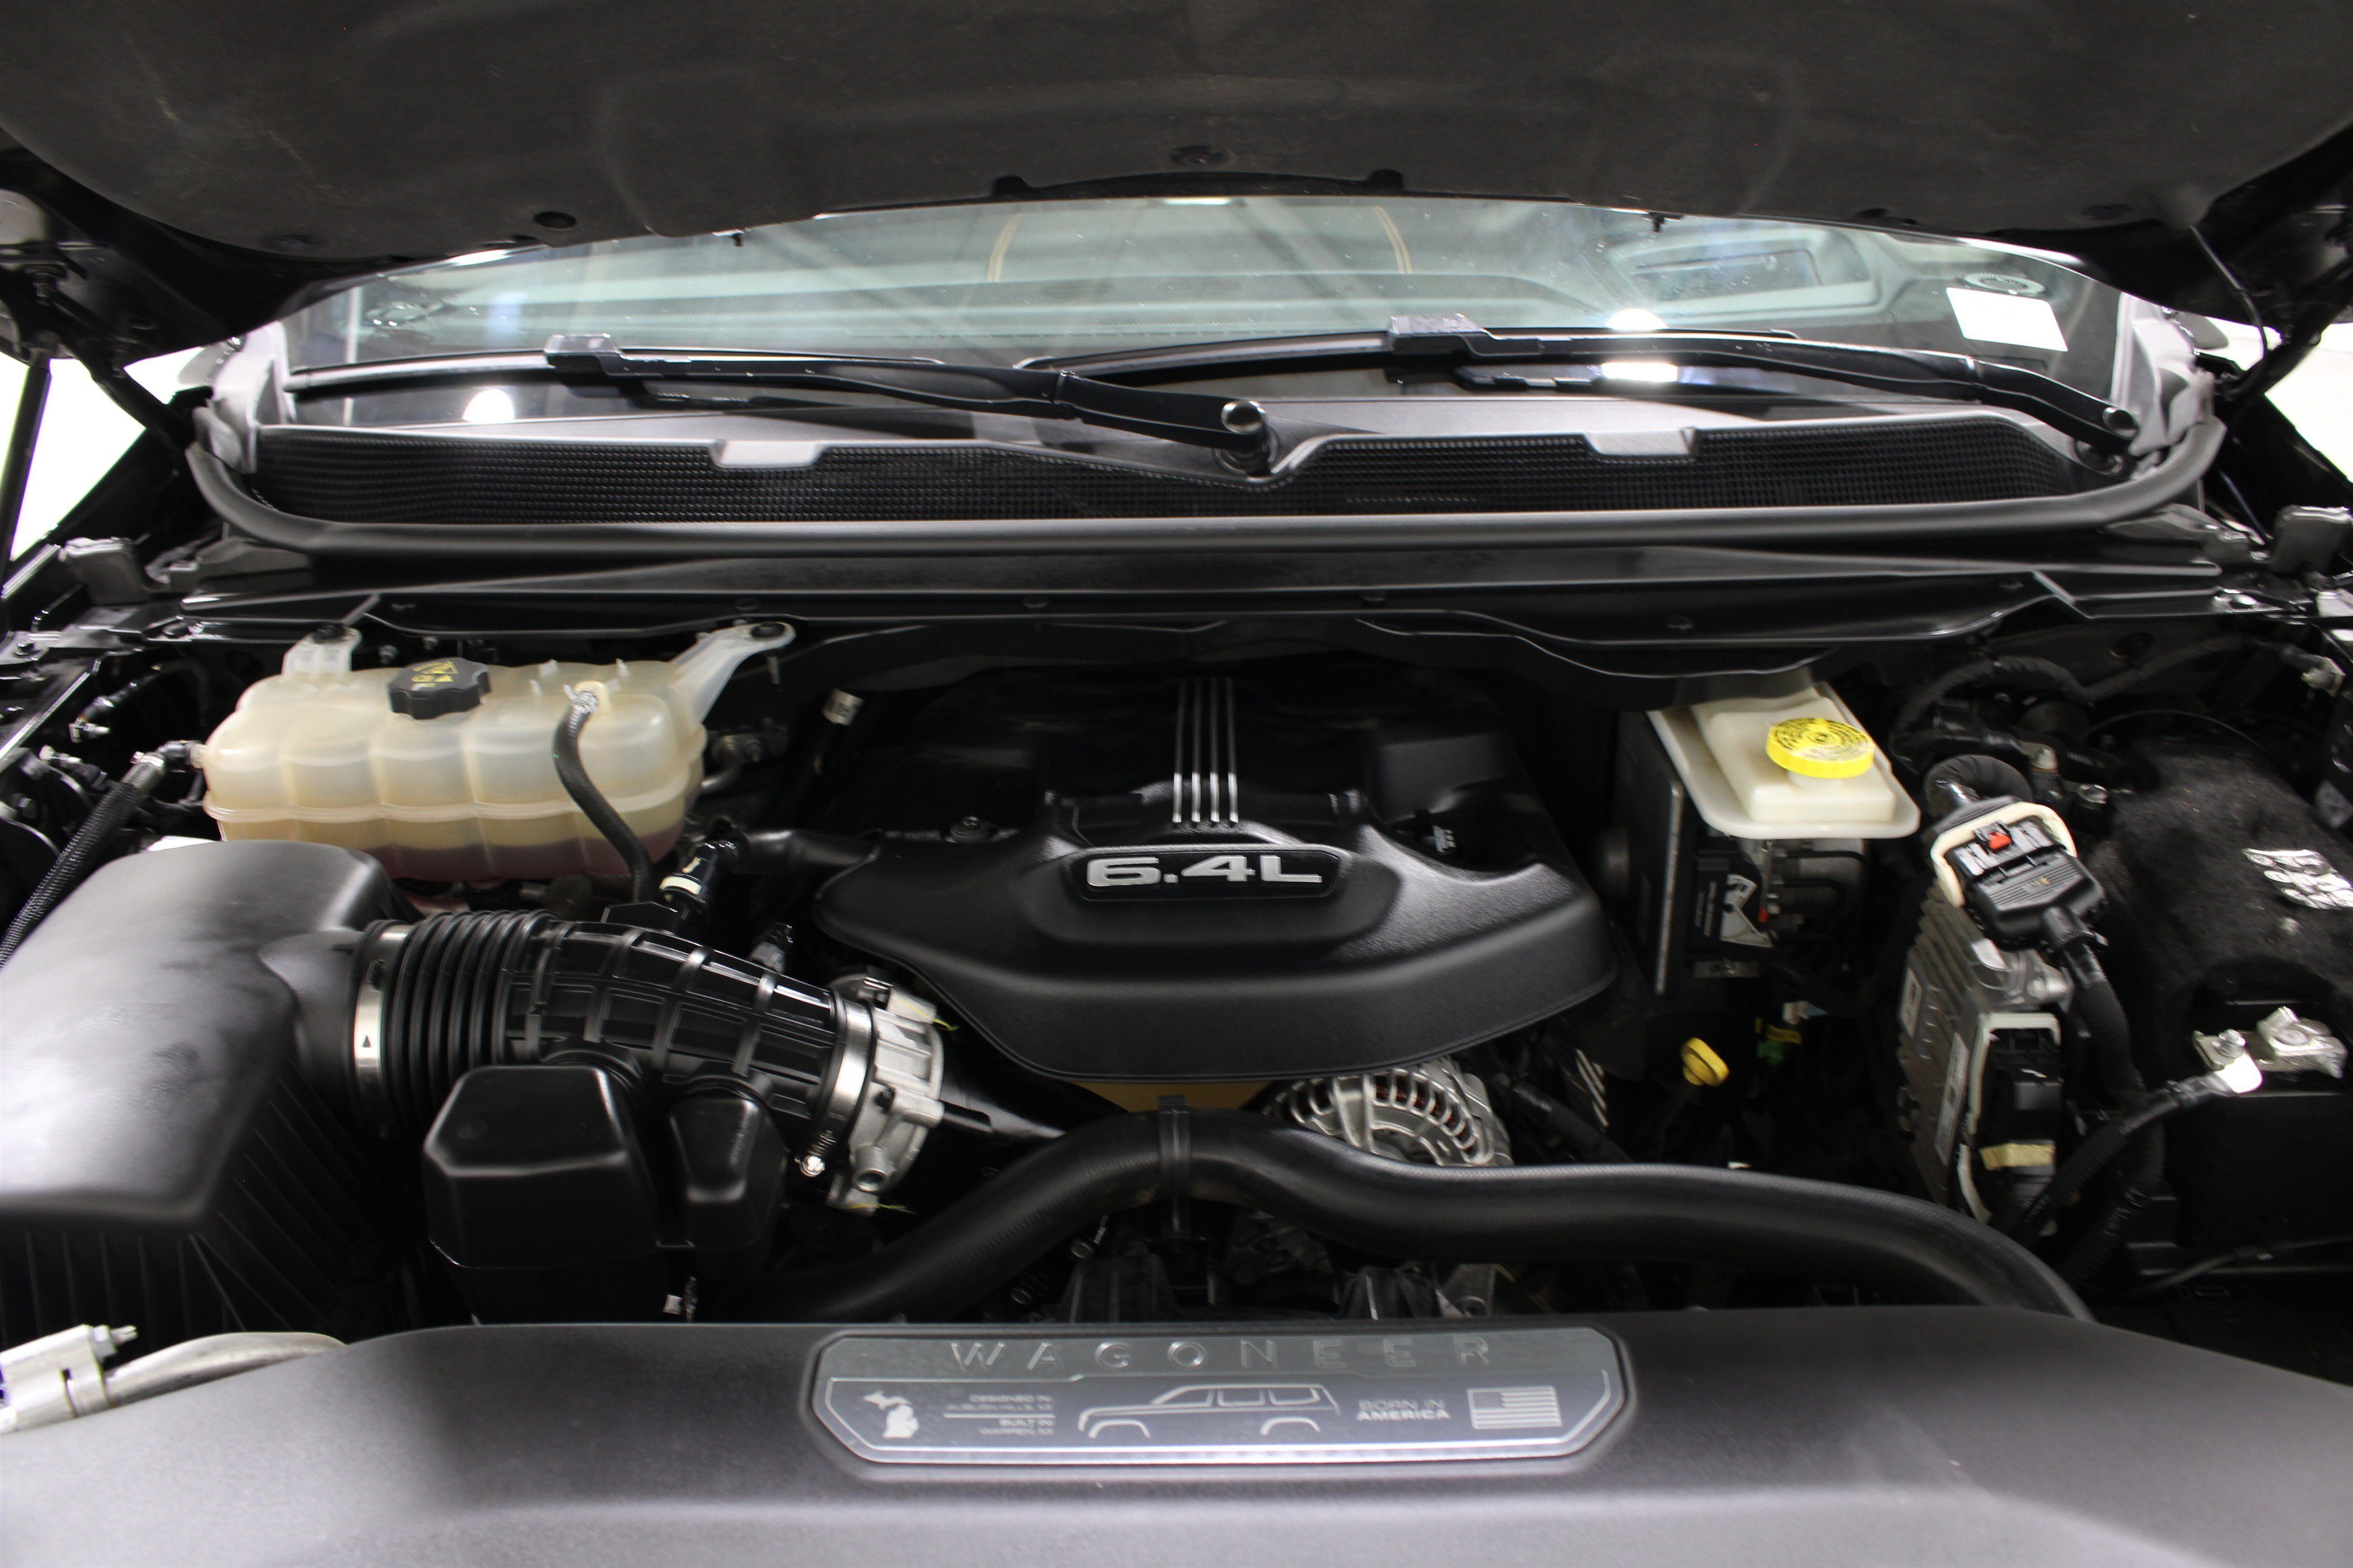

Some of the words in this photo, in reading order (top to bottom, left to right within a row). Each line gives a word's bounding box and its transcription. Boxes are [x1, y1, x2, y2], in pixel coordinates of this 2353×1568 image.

[1086, 855, 1323, 887] 6.4L
[950, 1335, 1490, 1372] WAGONEER
[1356, 1409, 1452, 1422] AMERICA
[1359, 1399, 1419, 1411] BORN
[1424, 1399, 1446, 1409] IN
